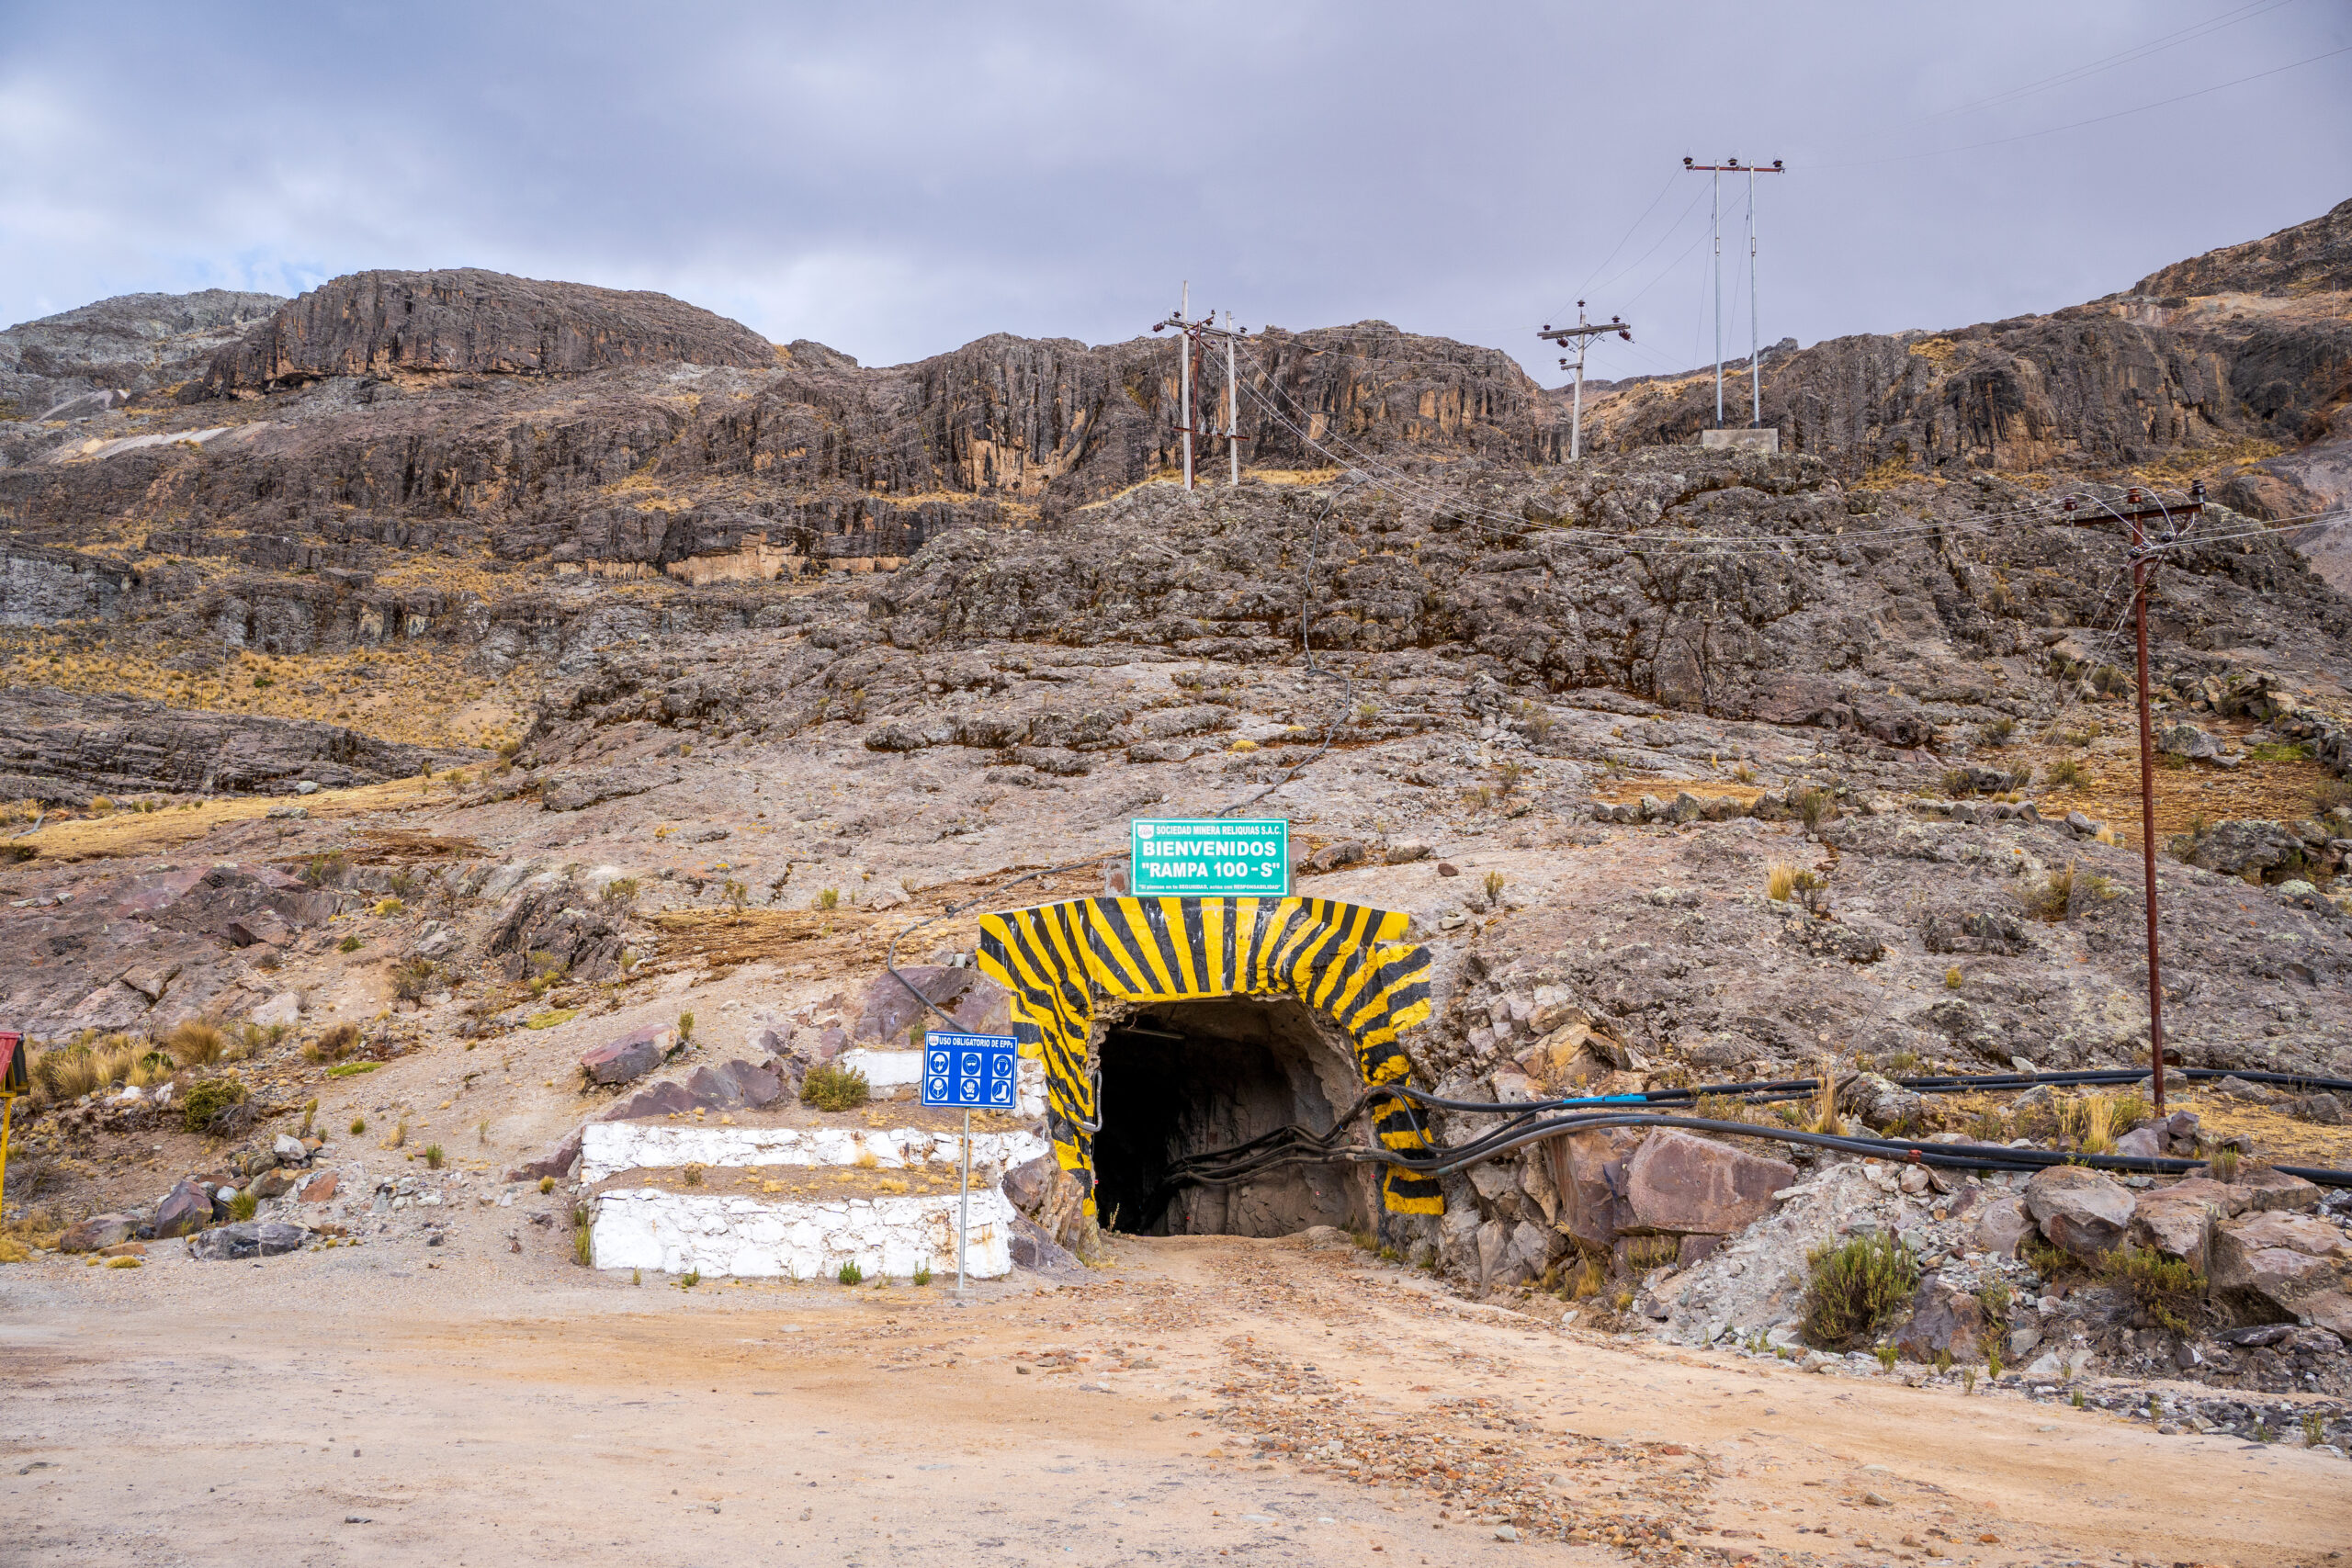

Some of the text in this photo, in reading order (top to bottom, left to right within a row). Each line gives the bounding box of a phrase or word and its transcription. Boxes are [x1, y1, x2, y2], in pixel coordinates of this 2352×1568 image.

[1156, 825, 1192, 835] SOCIEDAD
[1193, 825, 1220, 835] MINERA
[1222, 825, 1260, 836] RELIQUIAS
[1261, 825, 1282, 836] S.A.C.
[1143, 841, 1276, 856] BIENVENIDOS
[1142, 863, 1208, 877] "RAMPA
[939, 1037, 951, 1045] USO
[953, 1037, 989, 1047] OBLIGATORIO
[1000, 1040, 1013, 1049] EPPs
